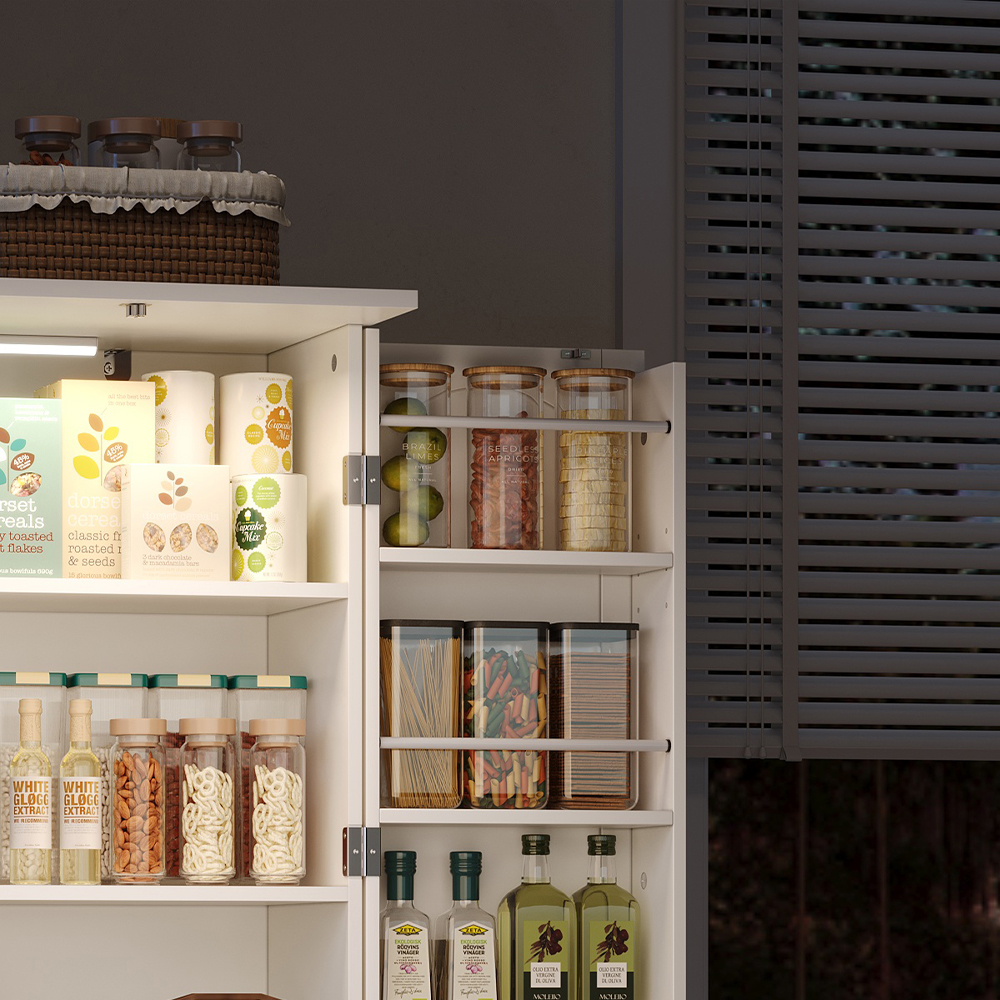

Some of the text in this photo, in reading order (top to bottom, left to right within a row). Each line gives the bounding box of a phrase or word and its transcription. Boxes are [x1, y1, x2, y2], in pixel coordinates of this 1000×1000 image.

[402, 443, 442, 451] BRAZIL
[488, 445, 538, 453] SEEDLESS
[488, 455, 539, 464] APRICOTS
[236, 521, 265, 535] Cupcake
[9, 532, 54, 542] toasted
[68, 531, 110, 541] classic
[242, 531, 260, 543] Mix
[7, 543, 44, 553] flakes
[68, 543, 115, 554] roasted
[68, 556, 116, 566] & seeds
[13, 780, 49, 793] WHITE
[63, 781, 99, 793] WHITE
[13, 793, 49, 806] GLØGG
[63, 794, 99, 806] GLØGG
[13, 806, 49, 815] EXTRACT
[63, 806, 99, 815] EXTRACT
